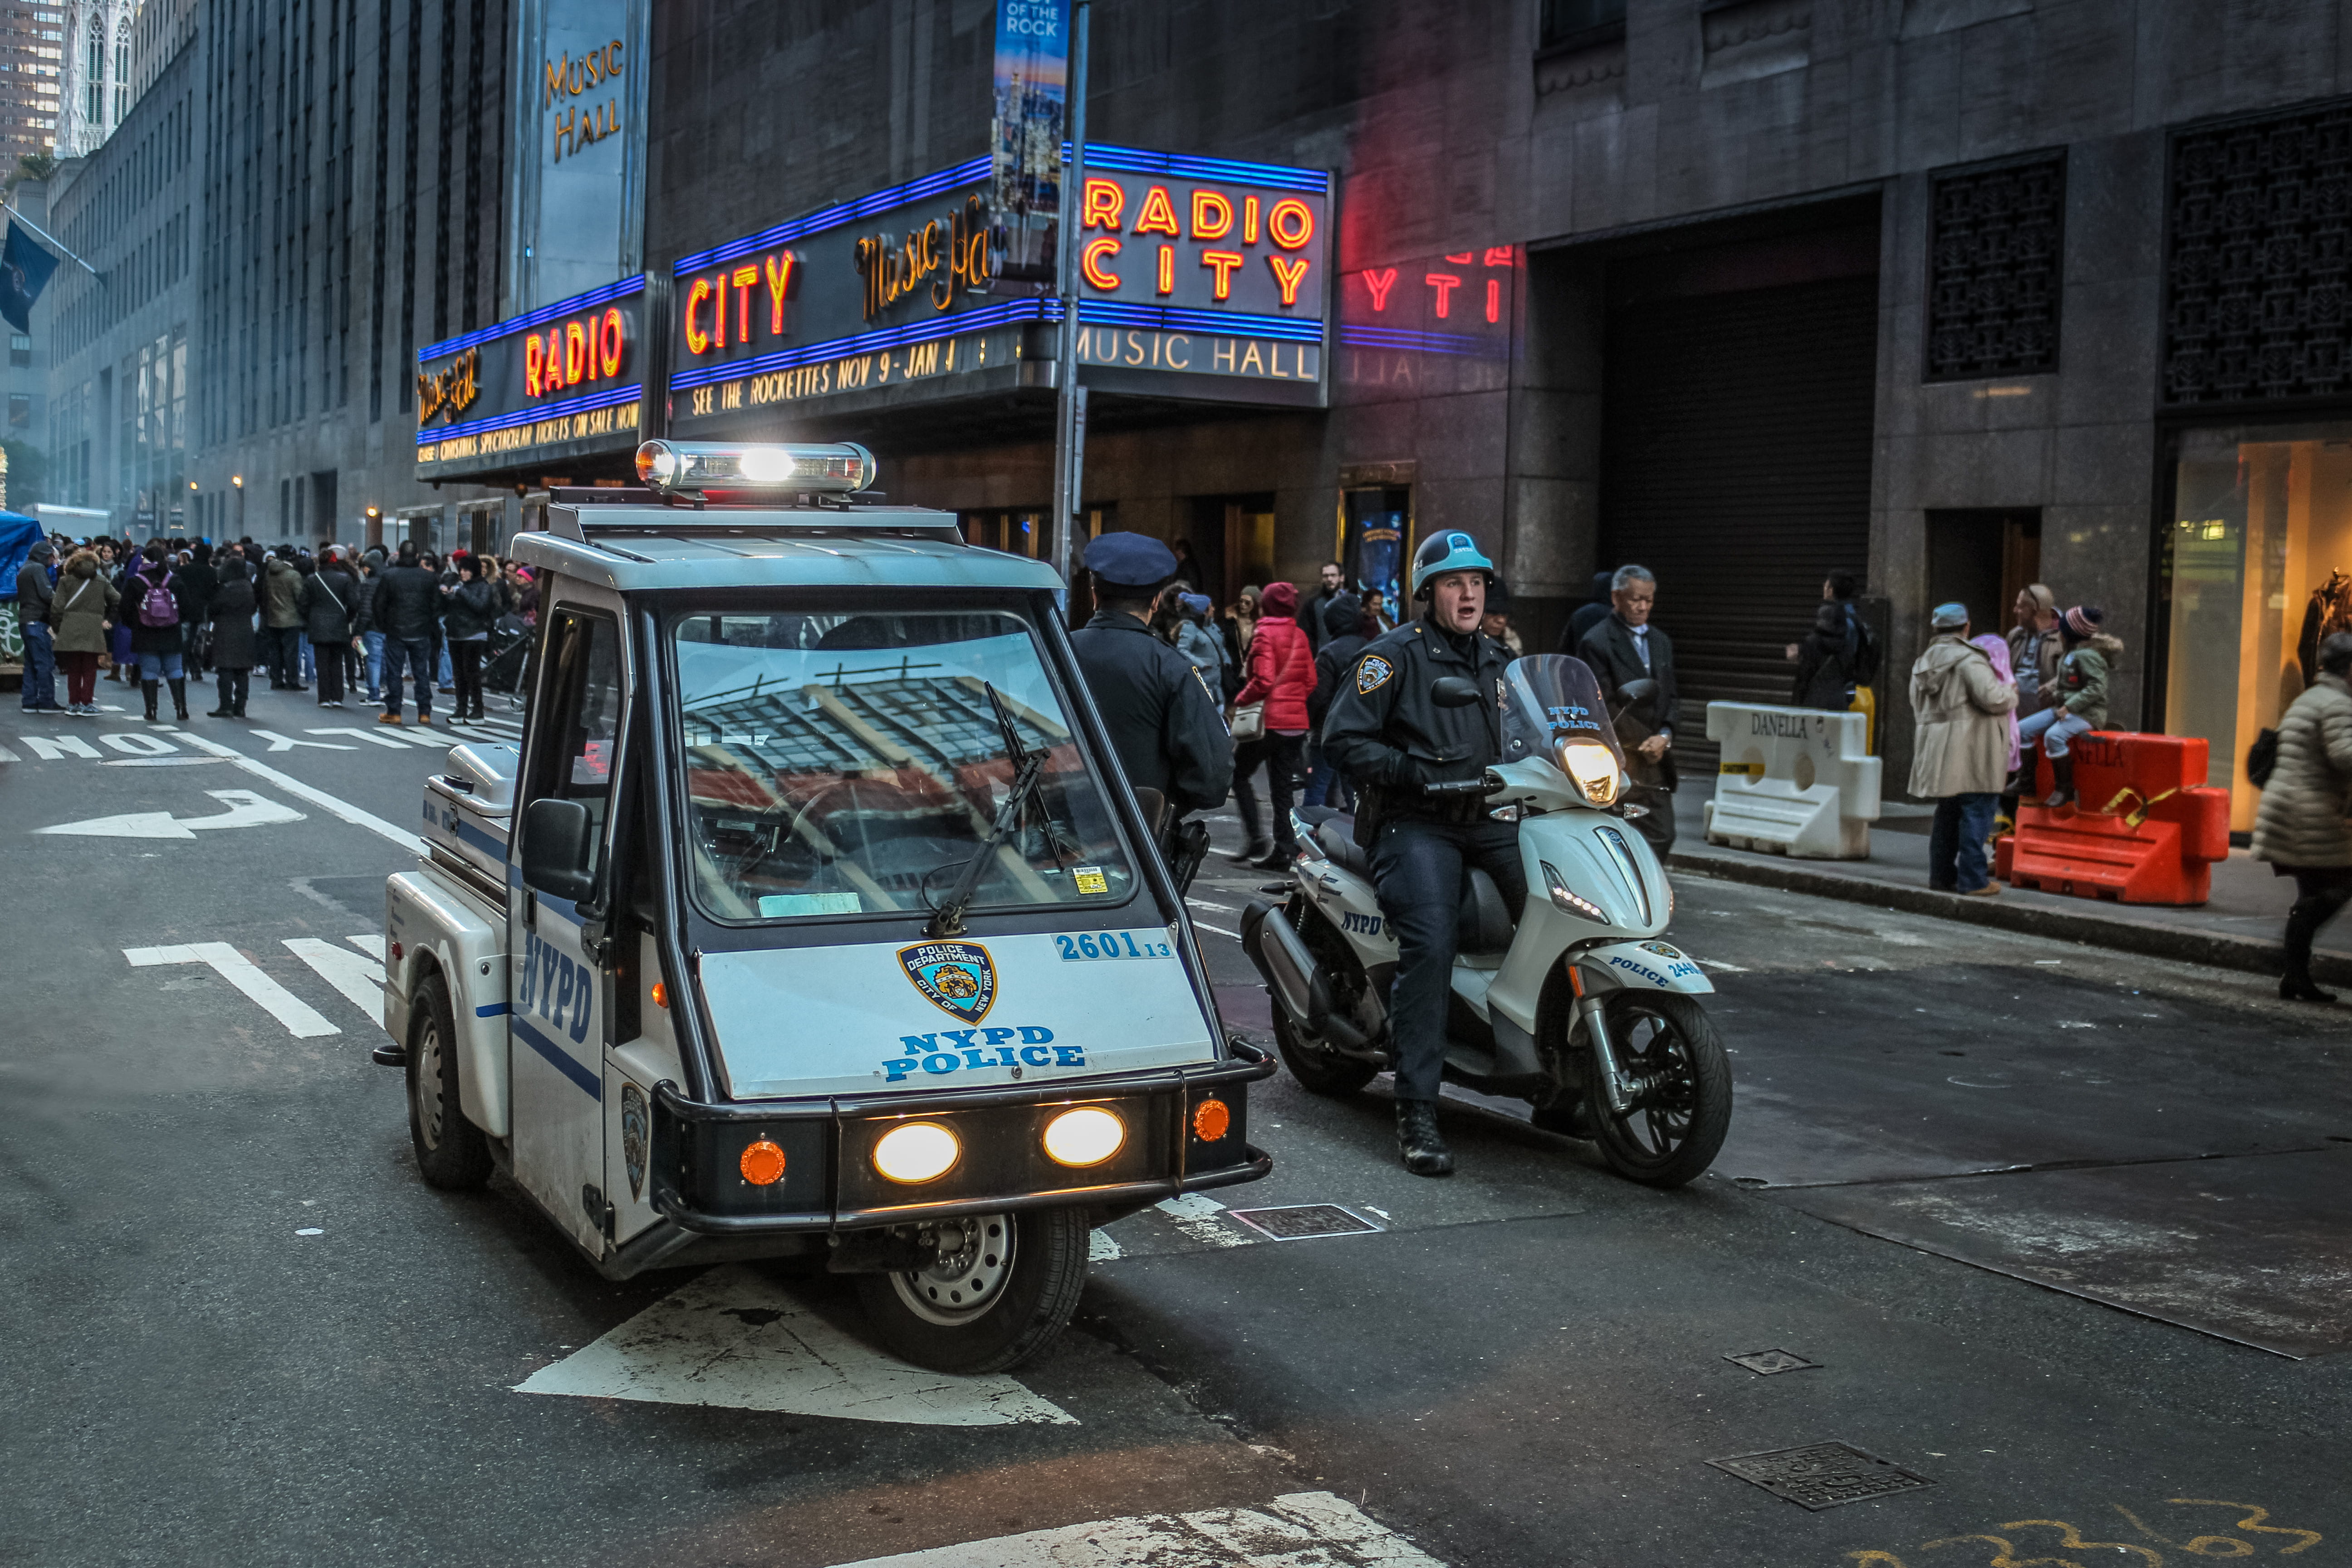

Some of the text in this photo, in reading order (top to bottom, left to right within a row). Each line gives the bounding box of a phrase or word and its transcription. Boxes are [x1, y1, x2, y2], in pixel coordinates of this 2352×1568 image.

[1007, 3, 1058, 20] OF THE
[1007, 16, 1057, 37] ROCK
[546, 40, 622, 110] MUSIC
[554, 98, 620, 163] HALL
[1083, 177, 1314, 250] RADIO
[932, 195, 989, 310] Ha
[1082, 236, 1310, 305] CITY
[686, 250, 795, 355] CITY
[525, 307, 622, 397] RADIO
[1213, 338, 1314, 380] HALL
[692, 386, 714, 416] SEE
[721, 381, 744, 410] THE
[750, 363, 830, 406] ROCKETTES
[837, 355, 872, 391] NOV
[878, 352, 891, 383] 9
[903, 342, 939, 379] JAN
[573, 413, 588, 438] ON
[589, 407, 614, 436] SALE
[616, 402, 640, 430] NOW
[1546, 720, 1601, 731] POLICE
[1548, 706, 1589, 715] NYPD
[1751, 713, 1808, 739] DANELLA
[1341, 911, 1382, 936] NYPD
[907, 953, 985, 971] DEPARTMENT
[917, 945, 965, 956] POLICE
[1056, 932, 1170, 960] 2601 13
[519, 930, 592, 1044] NYPD
[1609, 956, 1669, 988] POLICE
[916, 979, 958, 1011] CITY OF
[975, 969, 992, 1013] NEW YORK
[899, 1026, 1054, 1056] NYPD
[882, 1046, 1085, 1083] POLICE
